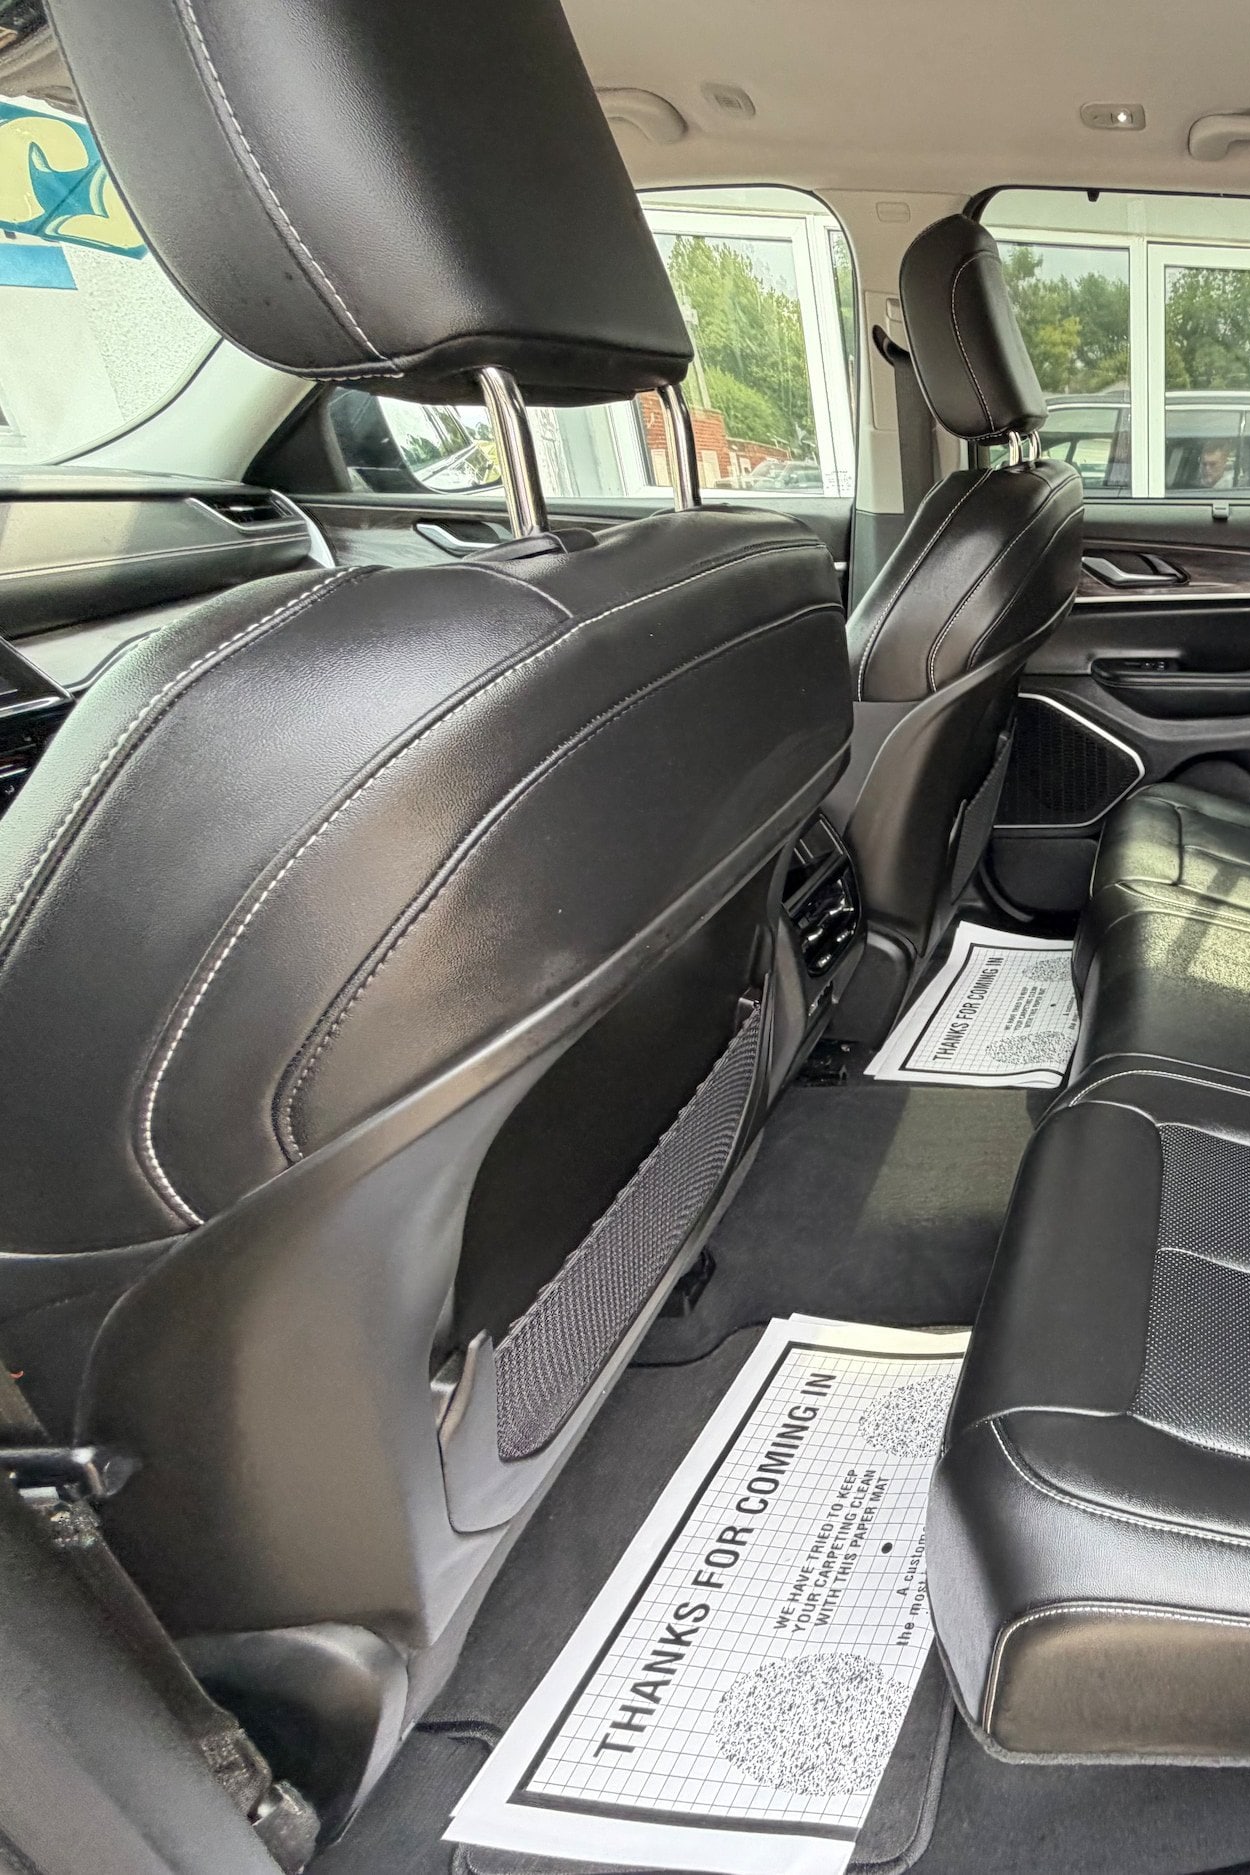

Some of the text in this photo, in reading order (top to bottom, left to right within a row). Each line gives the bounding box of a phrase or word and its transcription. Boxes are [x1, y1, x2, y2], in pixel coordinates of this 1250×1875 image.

[933, 957, 1004, 1061] THANKS FOR COMING IN
[593, 1372, 838, 1758] THANKS FOR COMING IN
[773, 1469, 858, 1630] WE HAVE TRIED TO KEEP
[791, 1469, 877, 1633] YOUR CARPETING CLEAN
[814, 1476, 890, 1627] WITH THIS PAPER MAT
[896, 1587, 910, 1597] A
[896, 1622, 915, 1646] the
